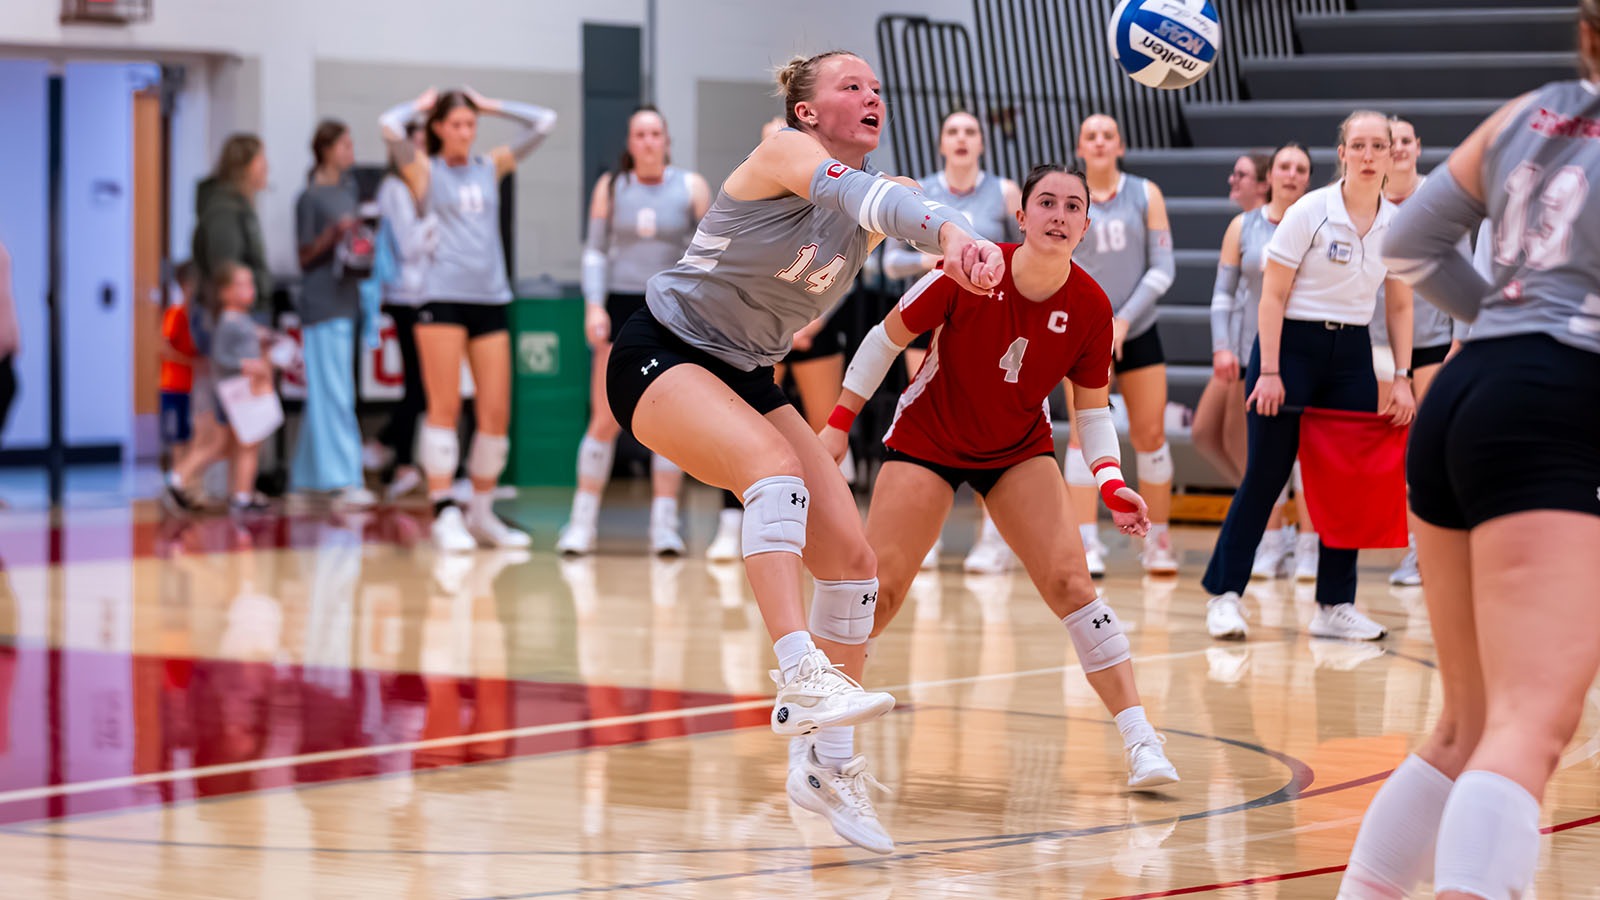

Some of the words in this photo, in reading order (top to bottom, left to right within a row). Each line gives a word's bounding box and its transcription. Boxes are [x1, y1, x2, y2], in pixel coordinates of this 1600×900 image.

[1142, 36, 1198, 71] molten
[1154, 19, 1206, 55] NCAA
[1095, 218, 1127, 252] 18
[774, 243, 846, 296] 14
[1047, 310, 1068, 333] C
[998, 336, 1029, 383] 4
